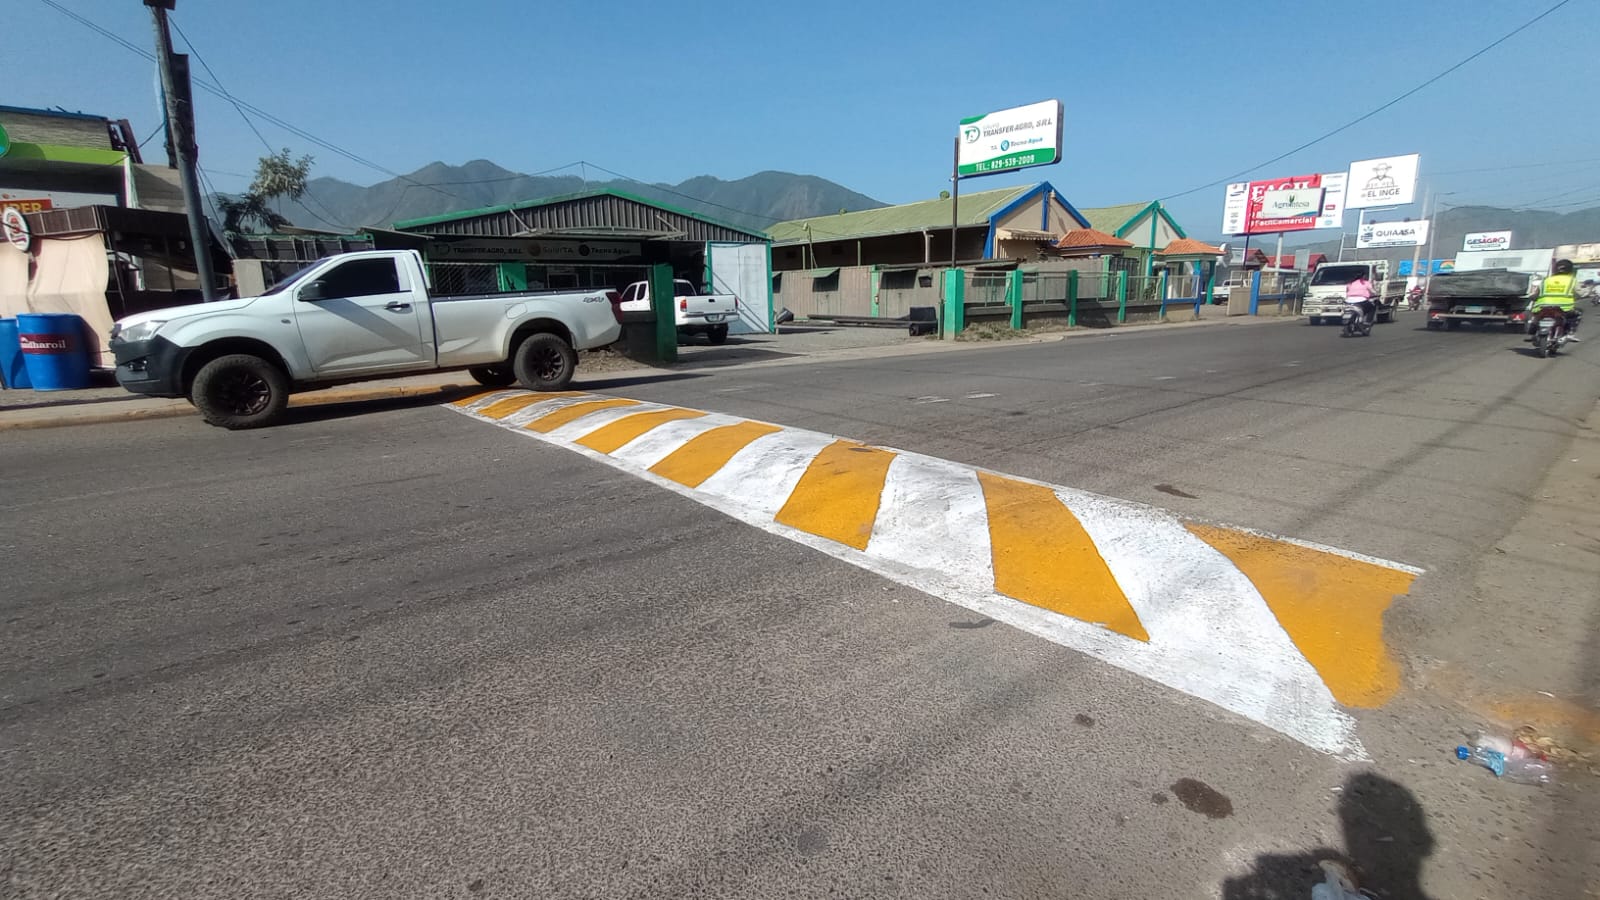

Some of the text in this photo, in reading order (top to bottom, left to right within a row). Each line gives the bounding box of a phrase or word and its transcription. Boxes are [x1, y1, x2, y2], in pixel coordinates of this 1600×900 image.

[983, 124, 1014, 137] TRANSFER
[1367, 190, 1377, 198] EL
[1379, 188, 1400, 197] INGE
